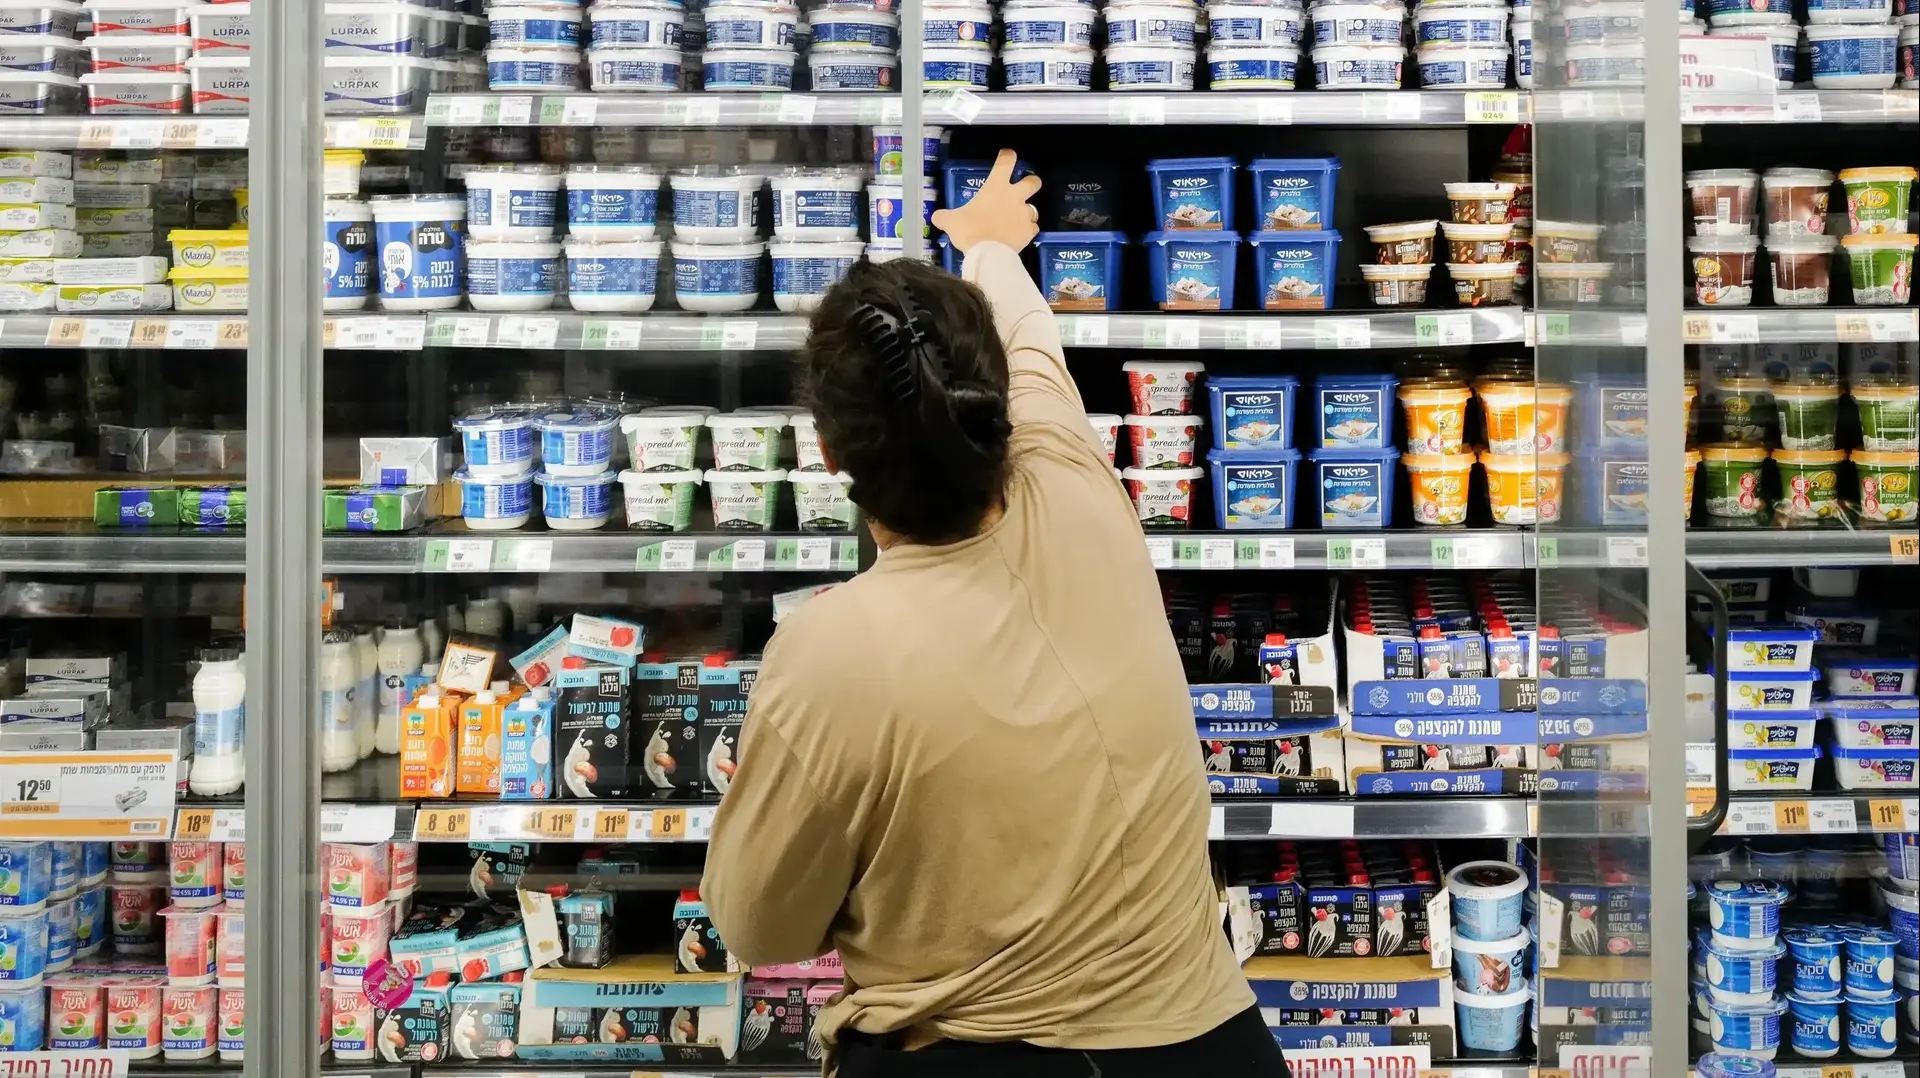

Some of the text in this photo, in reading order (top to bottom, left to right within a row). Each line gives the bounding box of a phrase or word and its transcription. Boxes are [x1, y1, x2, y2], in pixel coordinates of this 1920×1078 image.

[1696, 72, 1714, 88] על
[1172, 178, 1208, 186] פיראוס
[1273, 178, 1309, 186] פיראוס
[591, 195, 624, 203] פיראוס
[346, 232, 366, 245] טרה
[418, 233, 444, 245] טרה
[185, 252, 211, 261] Mazola
[1058, 251, 1093, 259] פיראוס
[1177, 251, 1211, 259] פיראוס
[1277, 250, 1312, 259] פיראוס
[431, 261, 454, 274] גבינה
[577, 263, 605, 271] פיראוס
[338, 275, 353, 289] 5%
[412, 275, 453, 289] לבנה 5%
[185, 289, 211, 298] Mazola
[1150, 384, 1191, 394] spread me
[1235, 396, 1271, 405] פיראוס
[1334, 394, 1369, 402] פיראוס
[643, 440, 688, 449] spread me
[719, 440, 761, 449] spread me
[1150, 439, 1191, 448] spread me
[1237, 470, 1273, 479] פיראוס
[1333, 468, 1368, 476] פיראוס
[628, 496, 655, 505] spread
[716, 495, 744, 505] spread
[803, 496, 831, 505] spread
[1142, 493, 1170, 502] spread
[1398, 654, 1412, 662] הלבן
[1466, 661, 1482, 670] שמנת
[680, 668, 696, 676] השף
[1397, 667, 1413, 676] שמנת
[601, 675, 617, 684] השף
[679, 676, 696, 685] הלבן
[601, 683, 618, 693] הלבן
[1452, 684, 1476, 696] שמנת
[648, 694, 698, 706] שמנת לבישול
[1227, 690, 1251, 700] שמנת
[1293, 691, 1309, 699] השף
[1406, 691, 1424, 703] חלבי
[1447, 694, 1481, 706] להקצפה
[568, 702, 620, 714] שמנת לבישול
[711, 700, 736, 712] לבישול
[1222, 700, 1255, 712] להקצפה
[1290, 699, 1313, 713] הלבן
[1210, 722, 1263, 732] תנובה
[1417, 719, 1501, 736] שמנת להקצפה
[507, 741, 525, 750] שמנת
[1249, 747, 1266, 755] שמנת
[1398, 749, 1414, 758] שמנת
[1242, 756, 1266, 766] להקצפה
[1390, 759, 1415, 769] להקצפה
[60, 765, 166, 775] לורפק עם שומן
[1233, 778, 1258, 788] שמנת
[1457, 775, 1480, 784] שמנת
[1410, 781, 1428, 790] חלבי
[1451, 782, 1485, 792] להקצפה
[332, 852, 353, 865] אשל
[1280, 894, 1293, 904] הלבן
[1354, 900, 1368, 910] הלבן
[1280, 908, 1296, 917] שמנת
[1274, 917, 1297, 928] להקצפה
[1353, 914, 1370, 923] שמנת
[337, 924, 361, 937] אשל
[579, 924, 599, 936] שמנת
[1347, 923, 1370, 933] להקצפה
[575, 936, 598, 948] לבישול
[1312, 983, 1397, 1001] שמנת להקצפה
[62, 995, 87, 1009] אשל
[115, 994, 139, 1008] אשל
[172, 996, 197, 1010] אשל
[335, 998, 357, 1010] אשל
[638, 1009, 658, 1021] שמנת
[1293, 1011, 1310, 1020] שמנת
[1361, 1011, 1377, 1020] שמנת
[417, 1019, 437, 1029] שמנת
[632, 1022, 658, 1034] לבישול
[411, 1029, 437, 1041] לבישול
[1345, 1032, 1369, 1042] שמנת
[191, 1040, 202, 1048] לבן
